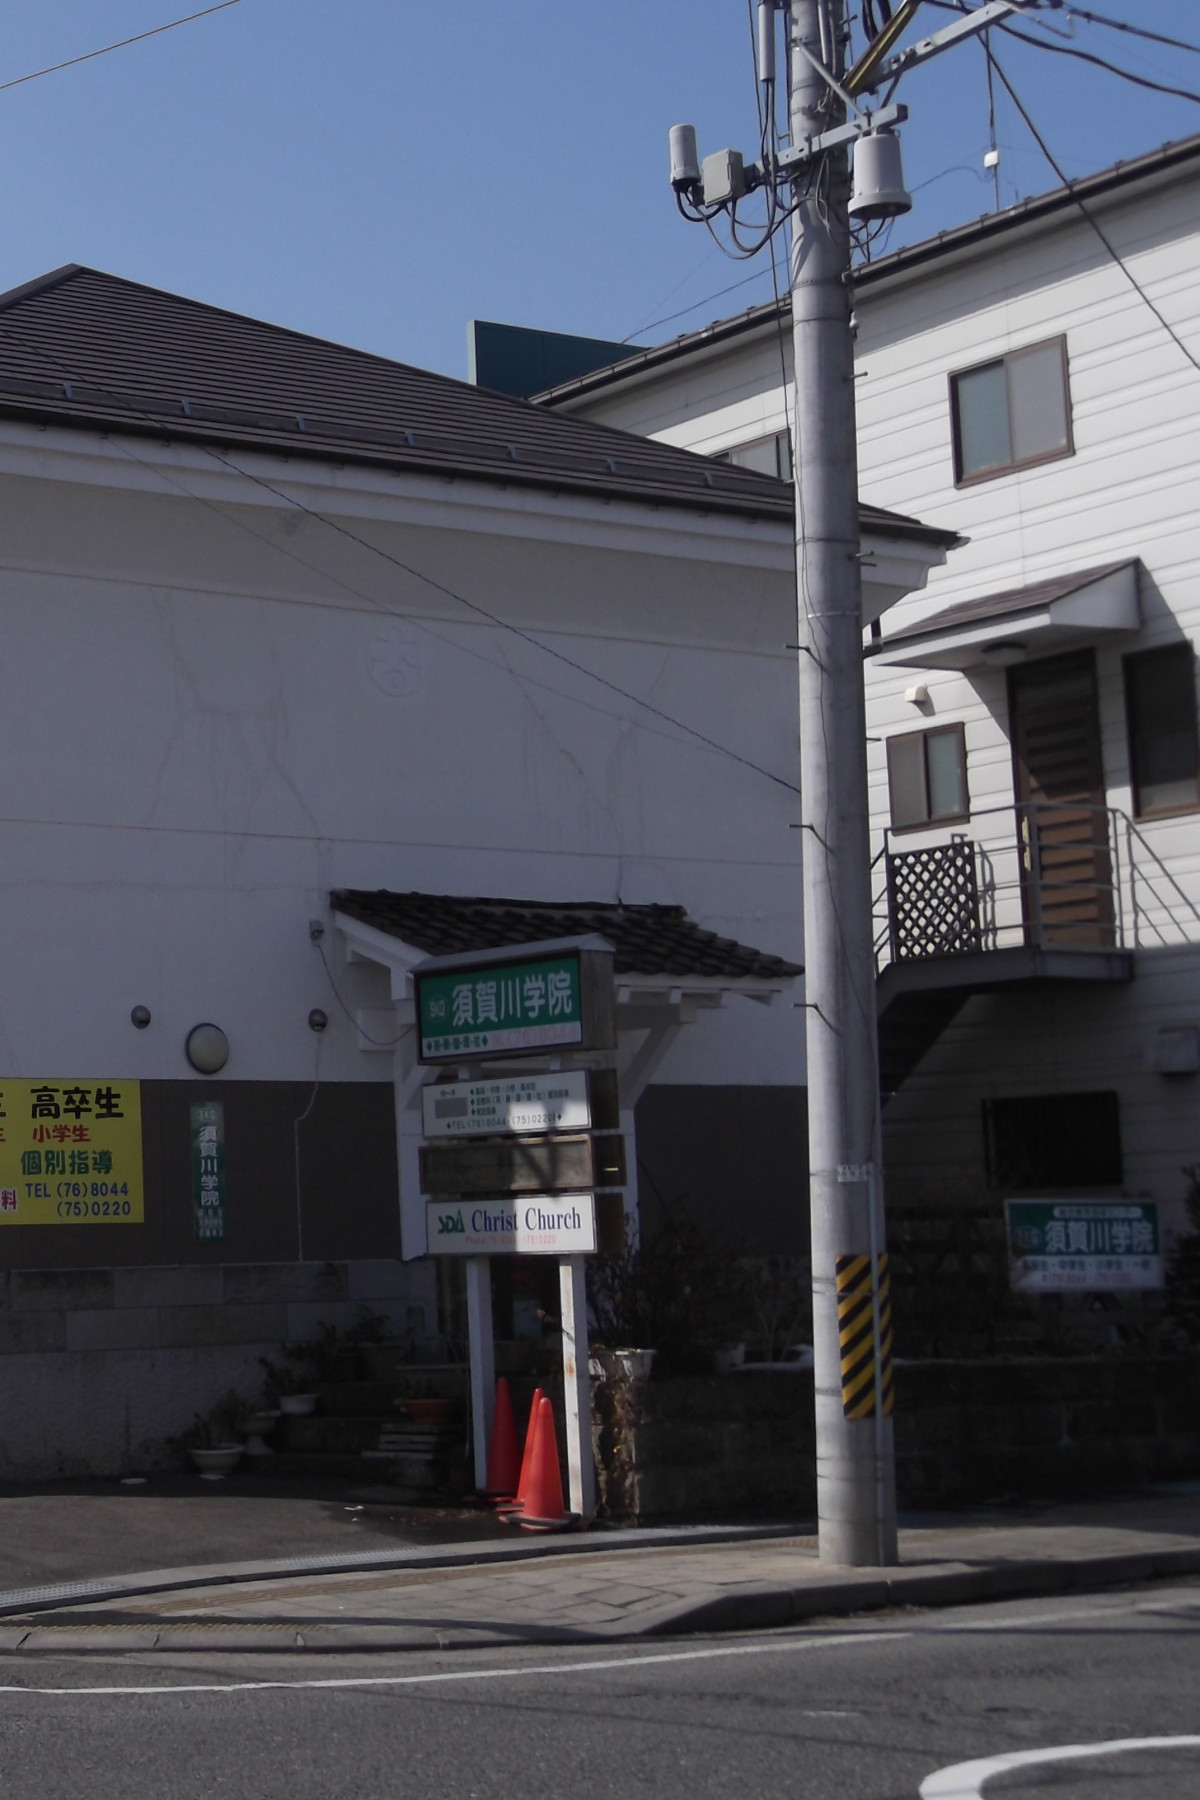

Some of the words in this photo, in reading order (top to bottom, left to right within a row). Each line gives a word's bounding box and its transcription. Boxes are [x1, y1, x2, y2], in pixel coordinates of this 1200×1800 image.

[452, 970, 573, 1027] 須賀川学院
[30, 1086, 125, 1119] 高卒生
[32, 1124, 91, 1143] 小学生
[21, 1150, 113, 1176] 個別指導
[199, 1125, 220, 1207] 須賀川学院
[25, 1183, 51, 1198] TEL
[57, 1182, 129, 1198] (76)8044
[57, 1201, 131, 1217] (75)0220
[438, 1208, 465, 1235] SDA
[472, 1208, 518, 1233] Christ
[525, 1206, 581, 1231] Church
[1045, 1220, 1154, 1253] 須賀川学院
